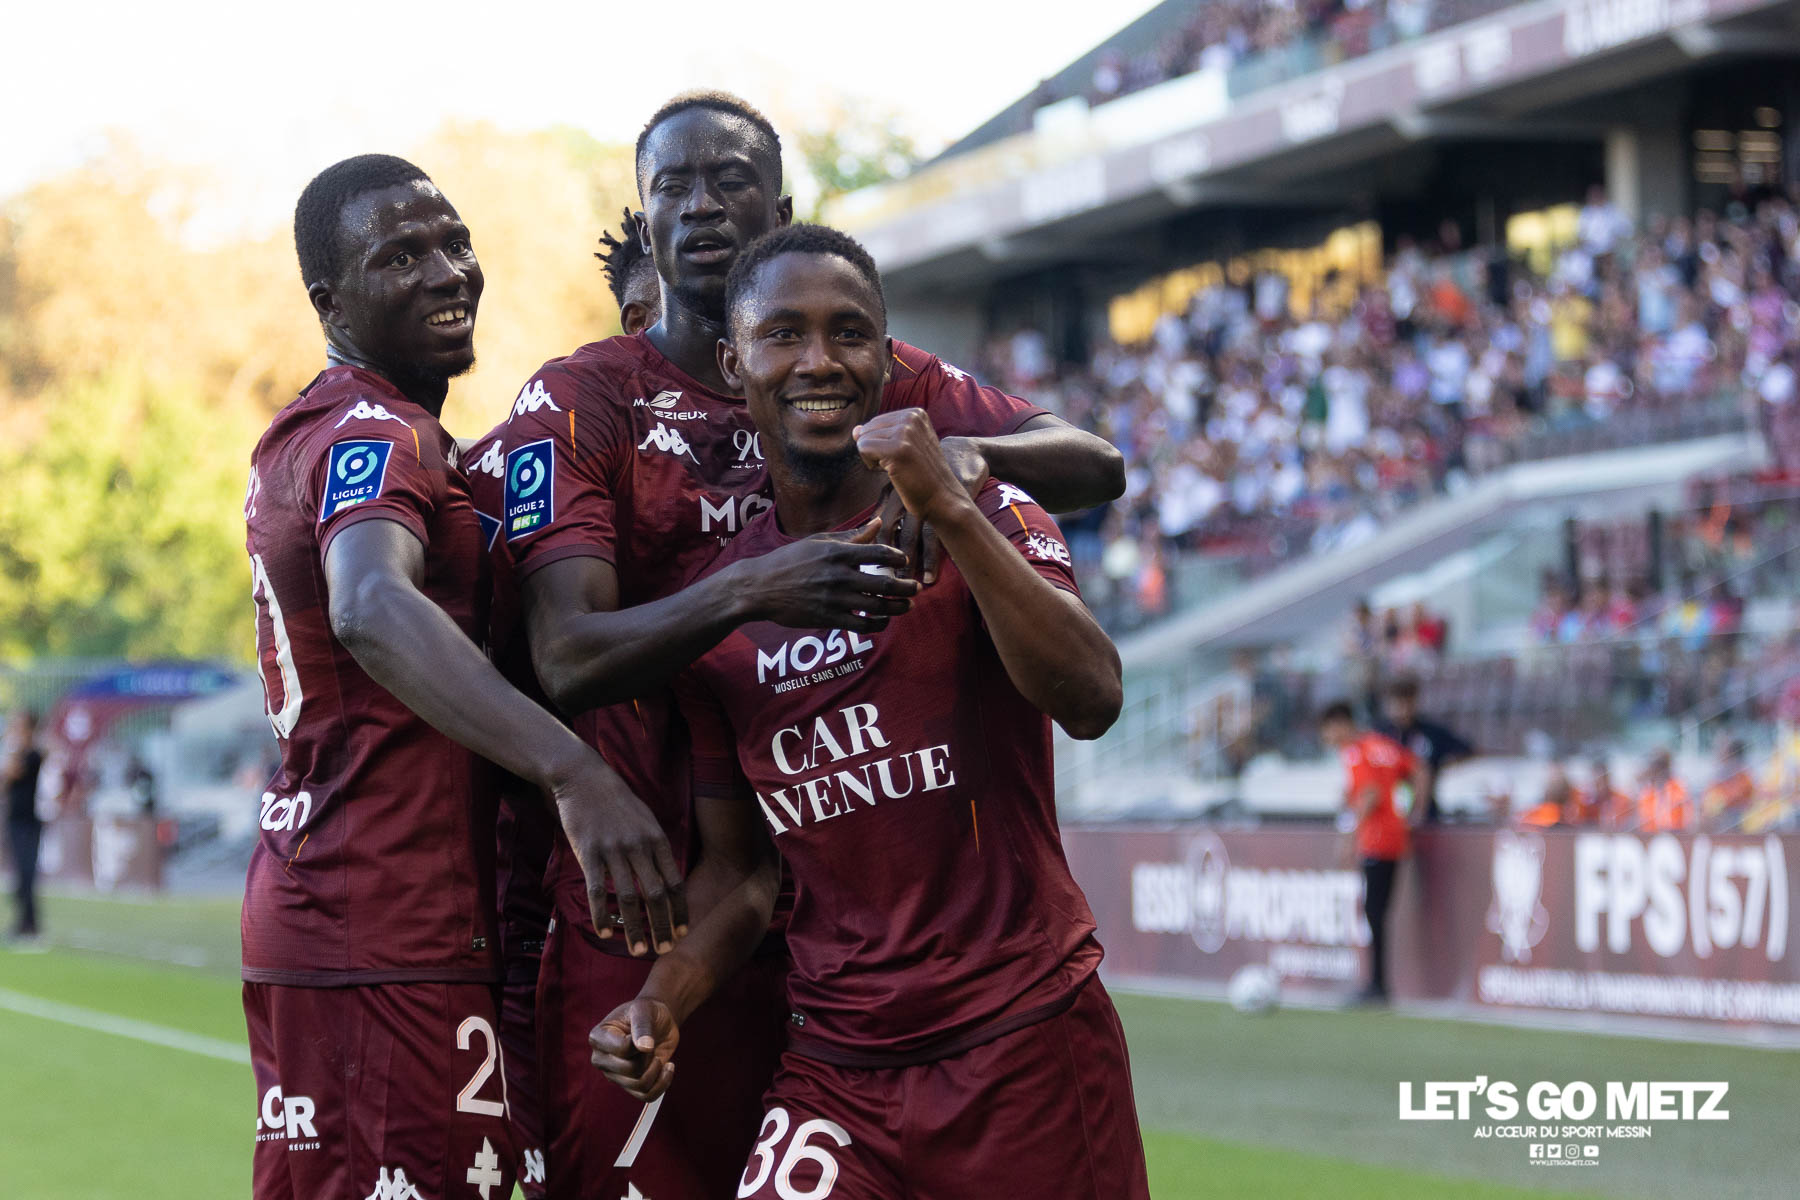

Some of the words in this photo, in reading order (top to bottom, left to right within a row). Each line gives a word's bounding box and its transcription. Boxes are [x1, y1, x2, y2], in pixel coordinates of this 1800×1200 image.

[332, 487, 364, 500] LIGUE
[366, 485, 374, 494] 2
[509, 501, 536, 516] LIGUE
[538, 499, 545, 509] 2
[772, 674, 811, 695] MOSELLE
[811, 668, 835, 684] SANS
[836, 658, 865, 677] LIMITE
[771, 703, 892, 775] CAR
[756, 744, 957, 836] AVENUE
[456, 1015, 512, 1121] 2
[256, 1084, 318, 1139] CR
[736, 1106, 853, 1200] 36
